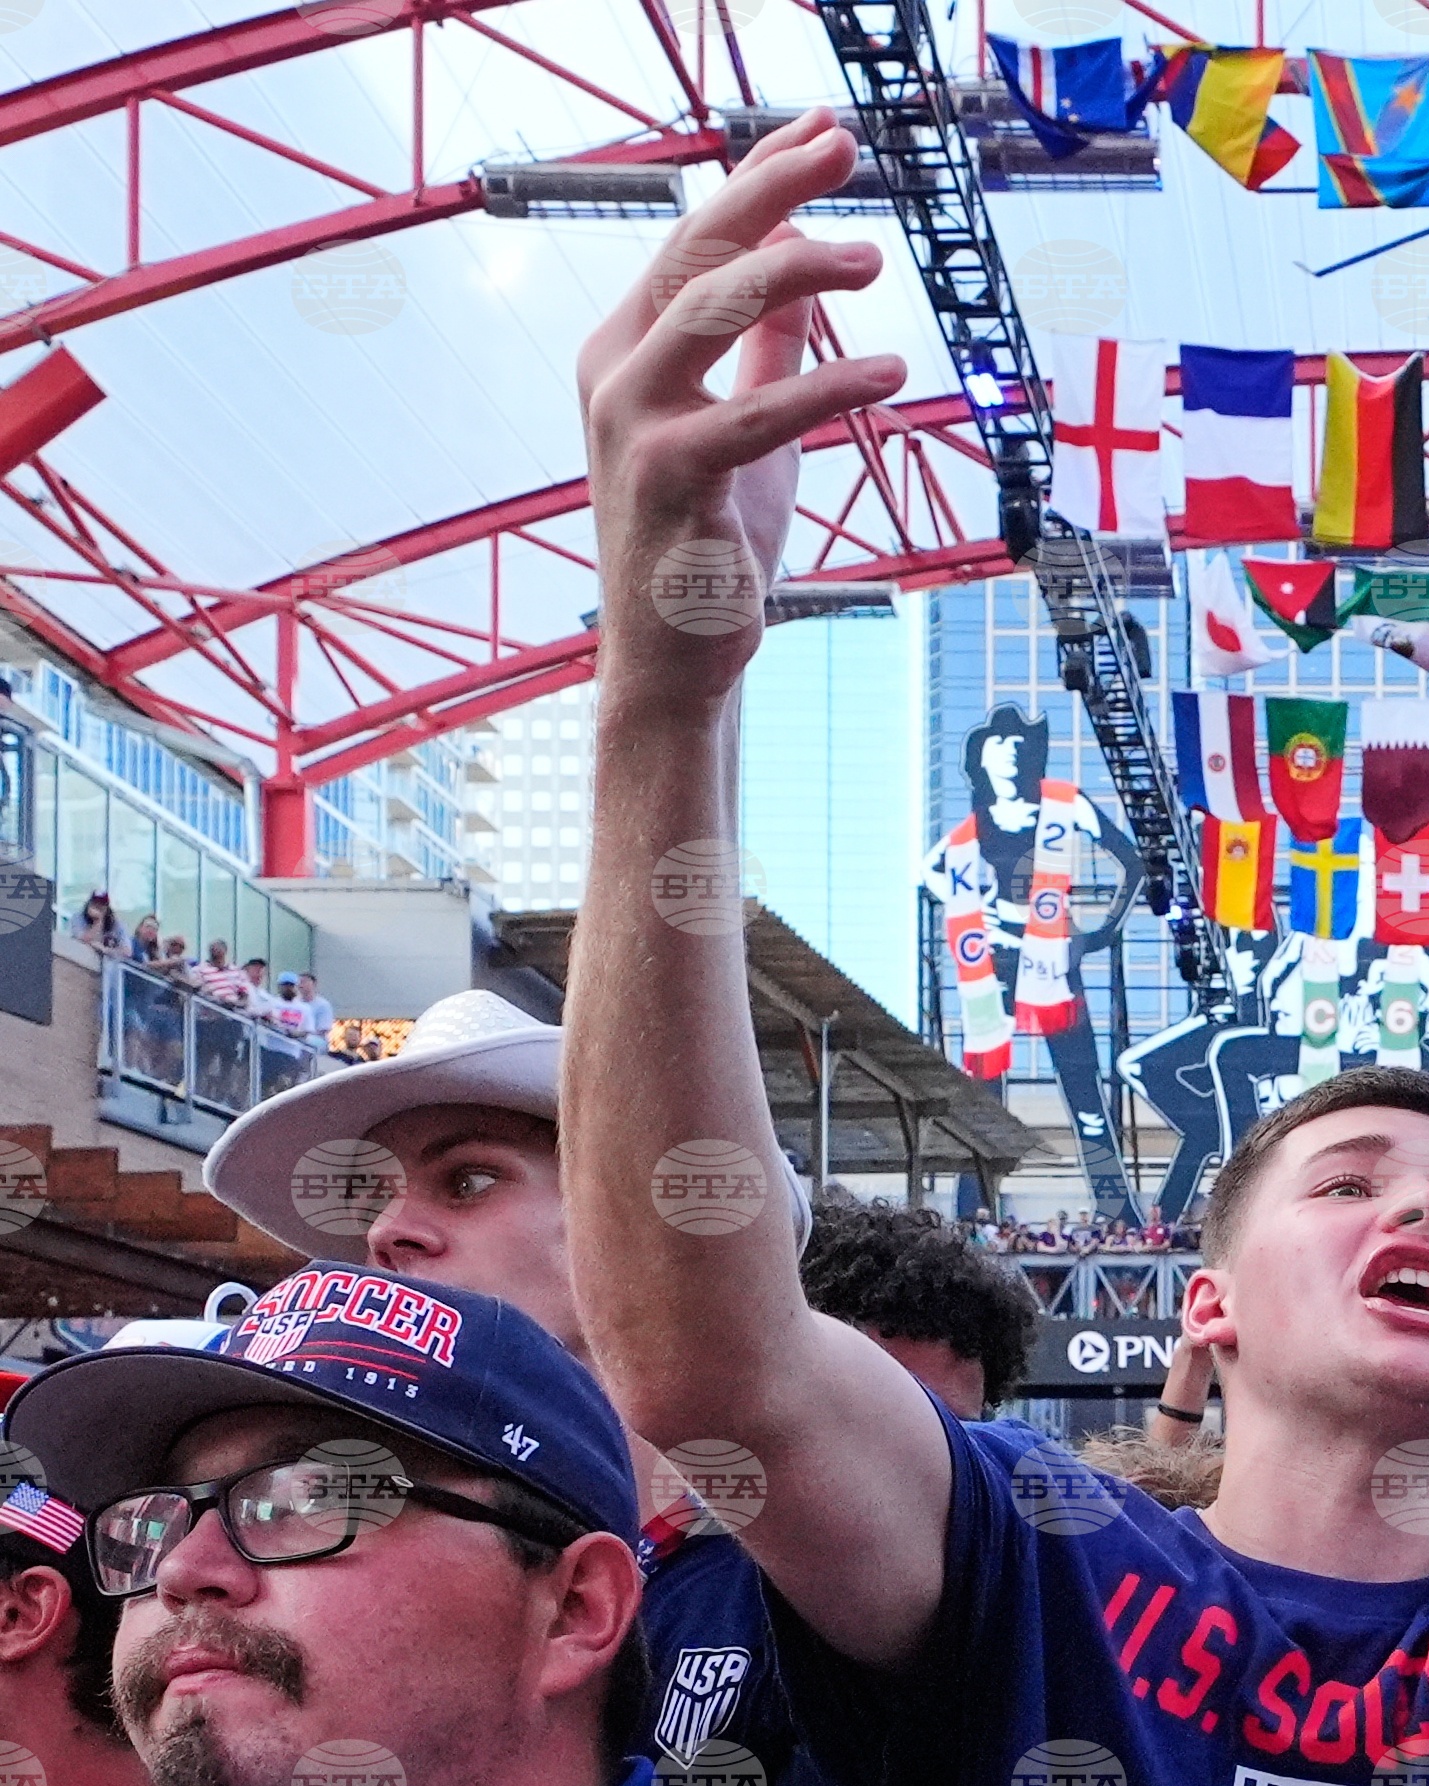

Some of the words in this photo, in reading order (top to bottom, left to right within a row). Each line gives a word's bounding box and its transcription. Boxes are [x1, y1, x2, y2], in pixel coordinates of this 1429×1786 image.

[1043, 823, 1066, 851] 2
[951, 862, 973, 895] K
[1034, 892, 1058, 920] 6
[960, 933, 984, 963] C
[1305, 998, 1336, 1034] C
[1385, 999, 1414, 1034] 6
[237, 1270, 463, 1368] SOCCER
[1114, 1335, 1181, 1368] PN
[677, 1653, 748, 1695] USA
